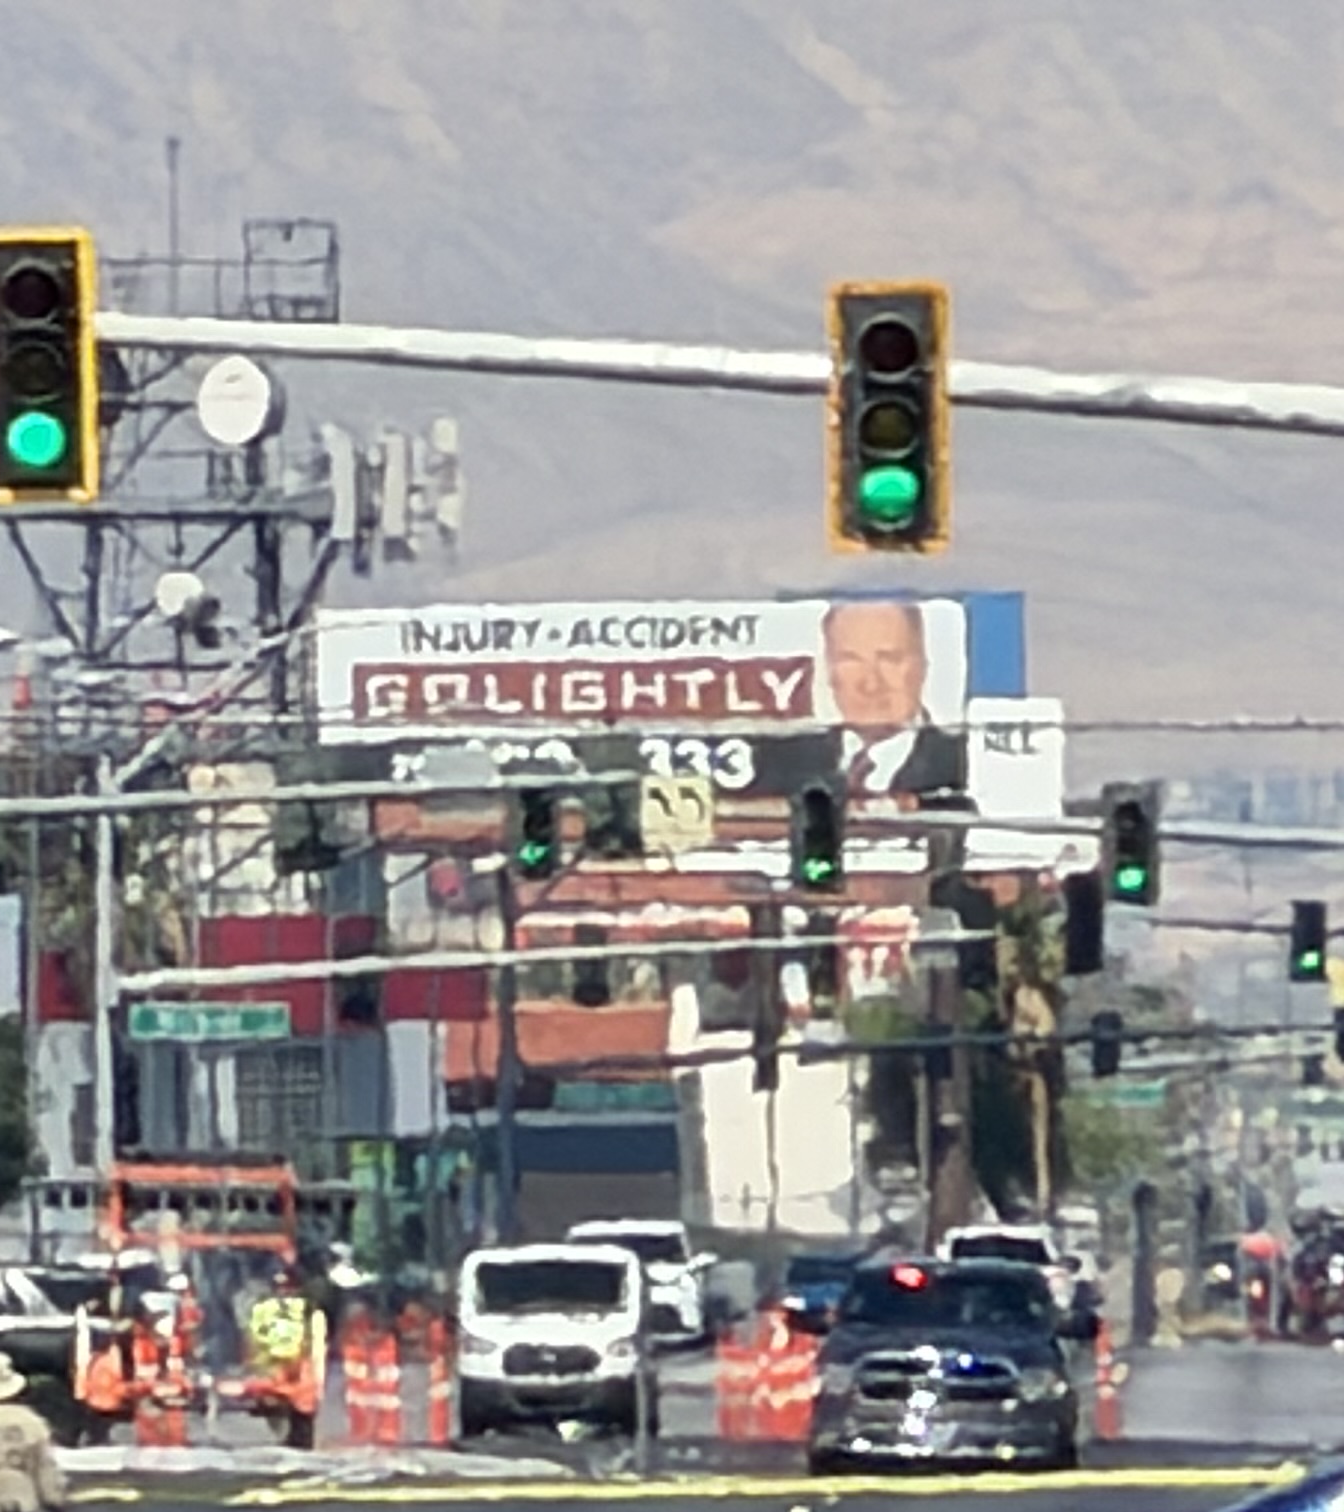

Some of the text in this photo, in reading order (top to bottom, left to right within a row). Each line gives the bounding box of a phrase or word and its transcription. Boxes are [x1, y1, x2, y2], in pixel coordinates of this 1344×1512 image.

[400, 615, 759, 653] INJURY ACCIDENT
[364, 670, 805, 718] GOLIGHTLY
